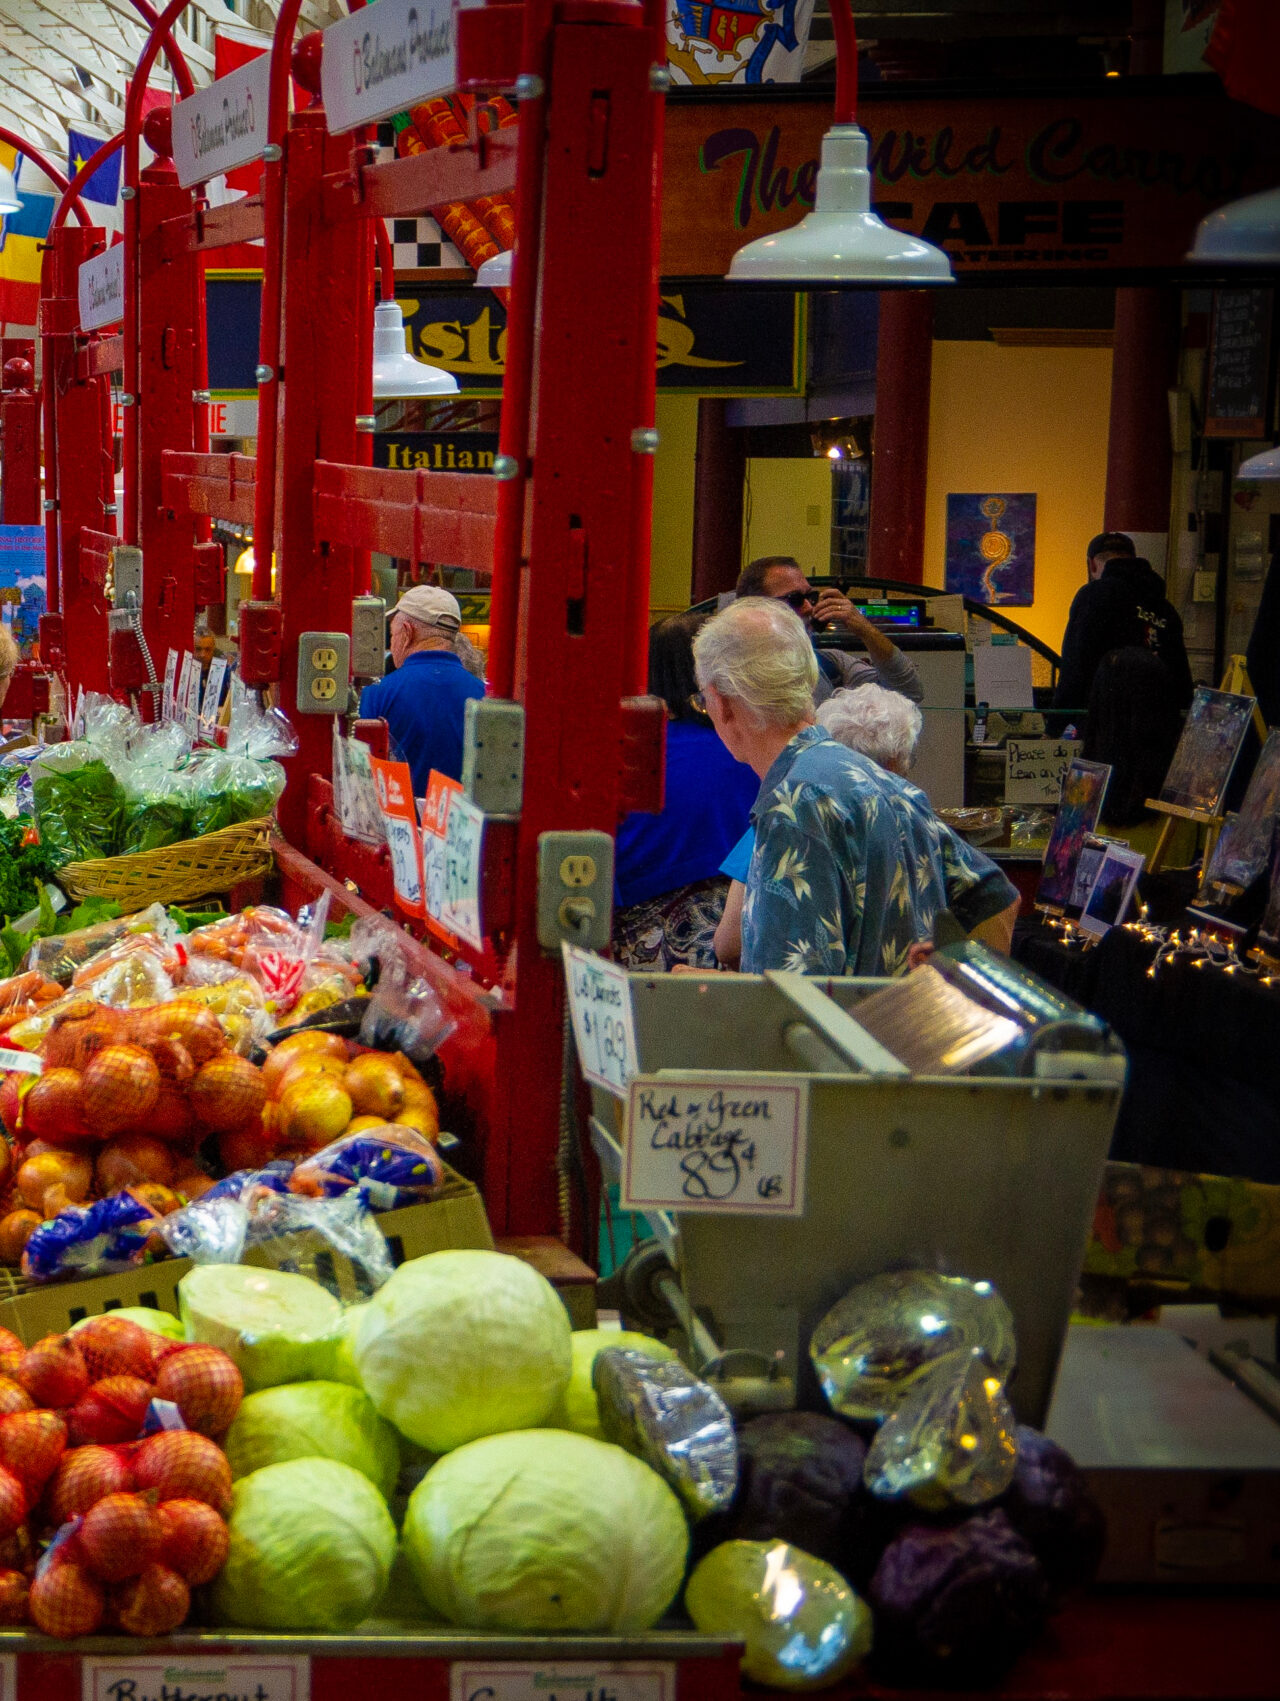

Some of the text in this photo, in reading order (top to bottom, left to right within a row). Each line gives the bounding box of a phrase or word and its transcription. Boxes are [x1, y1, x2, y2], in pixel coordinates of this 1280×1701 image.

[699, 124, 820, 230] The
[870, 125, 1010, 186] Wild
[387, 443, 496, 469] Italian
[1009, 743, 1045, 763] Please
[1053, 745, 1068, 757] do
[640, 1090, 681, 1121] Red
[704, 1089, 770, 1132] Green
